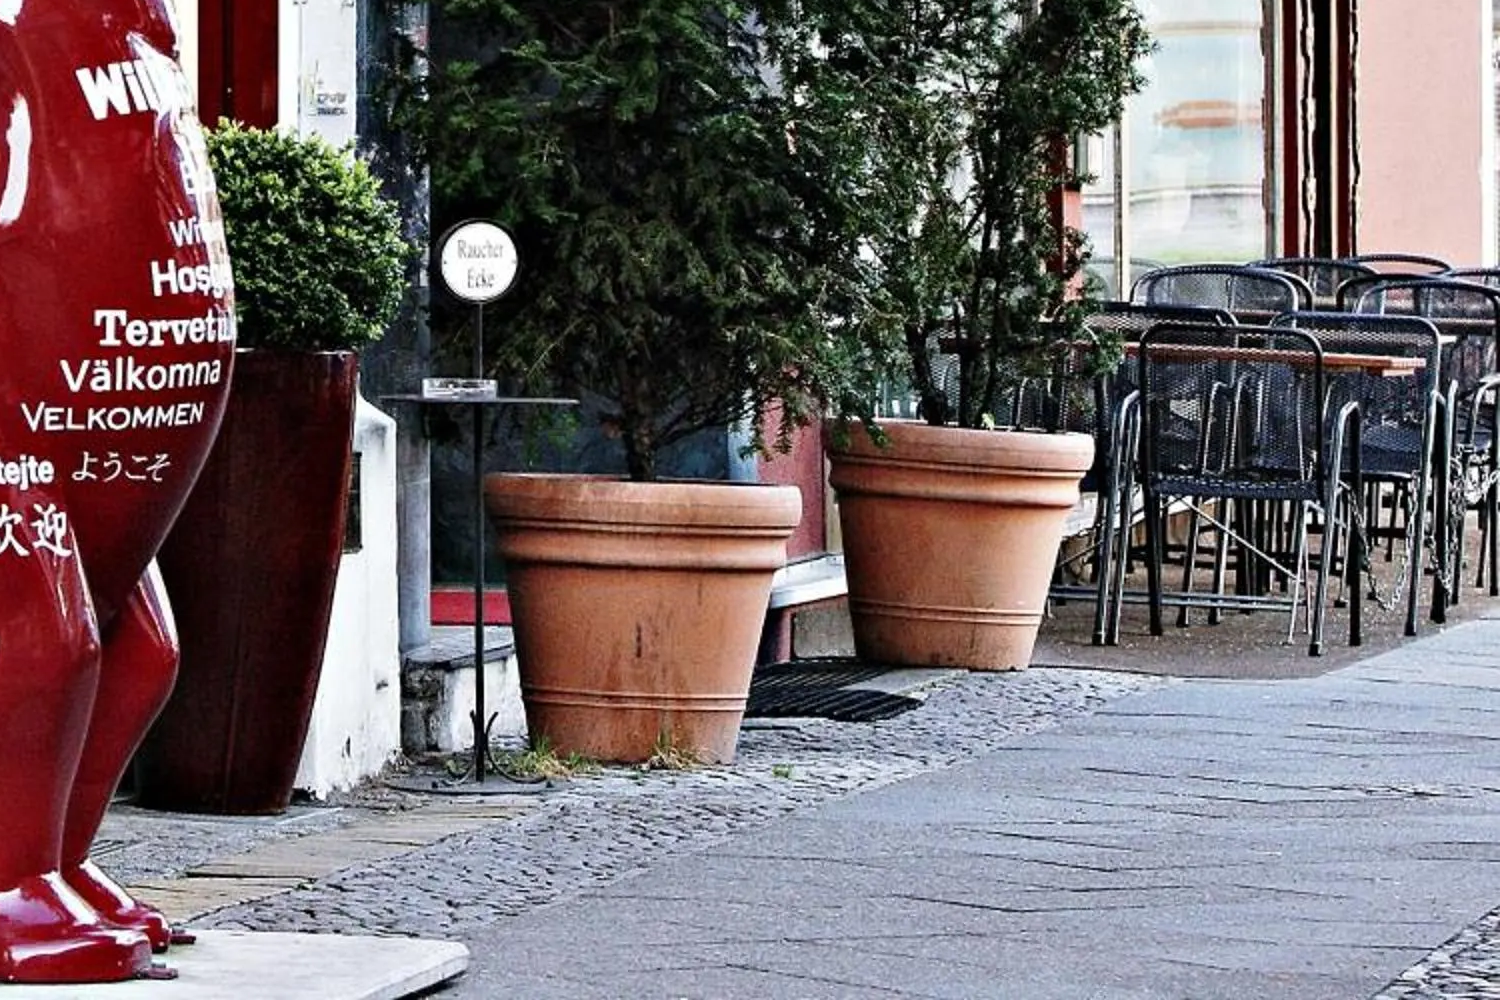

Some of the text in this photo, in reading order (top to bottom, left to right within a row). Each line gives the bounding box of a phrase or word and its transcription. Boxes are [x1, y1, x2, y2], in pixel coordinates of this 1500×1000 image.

[456, 239, 504, 259] Raucher
[466, 268, 496, 289] Ecke
[59, 356, 222, 393] Välkomna
[20, 401, 205, 433] VELKOMMEN
[71, 451, 172, 483] ようこそ
